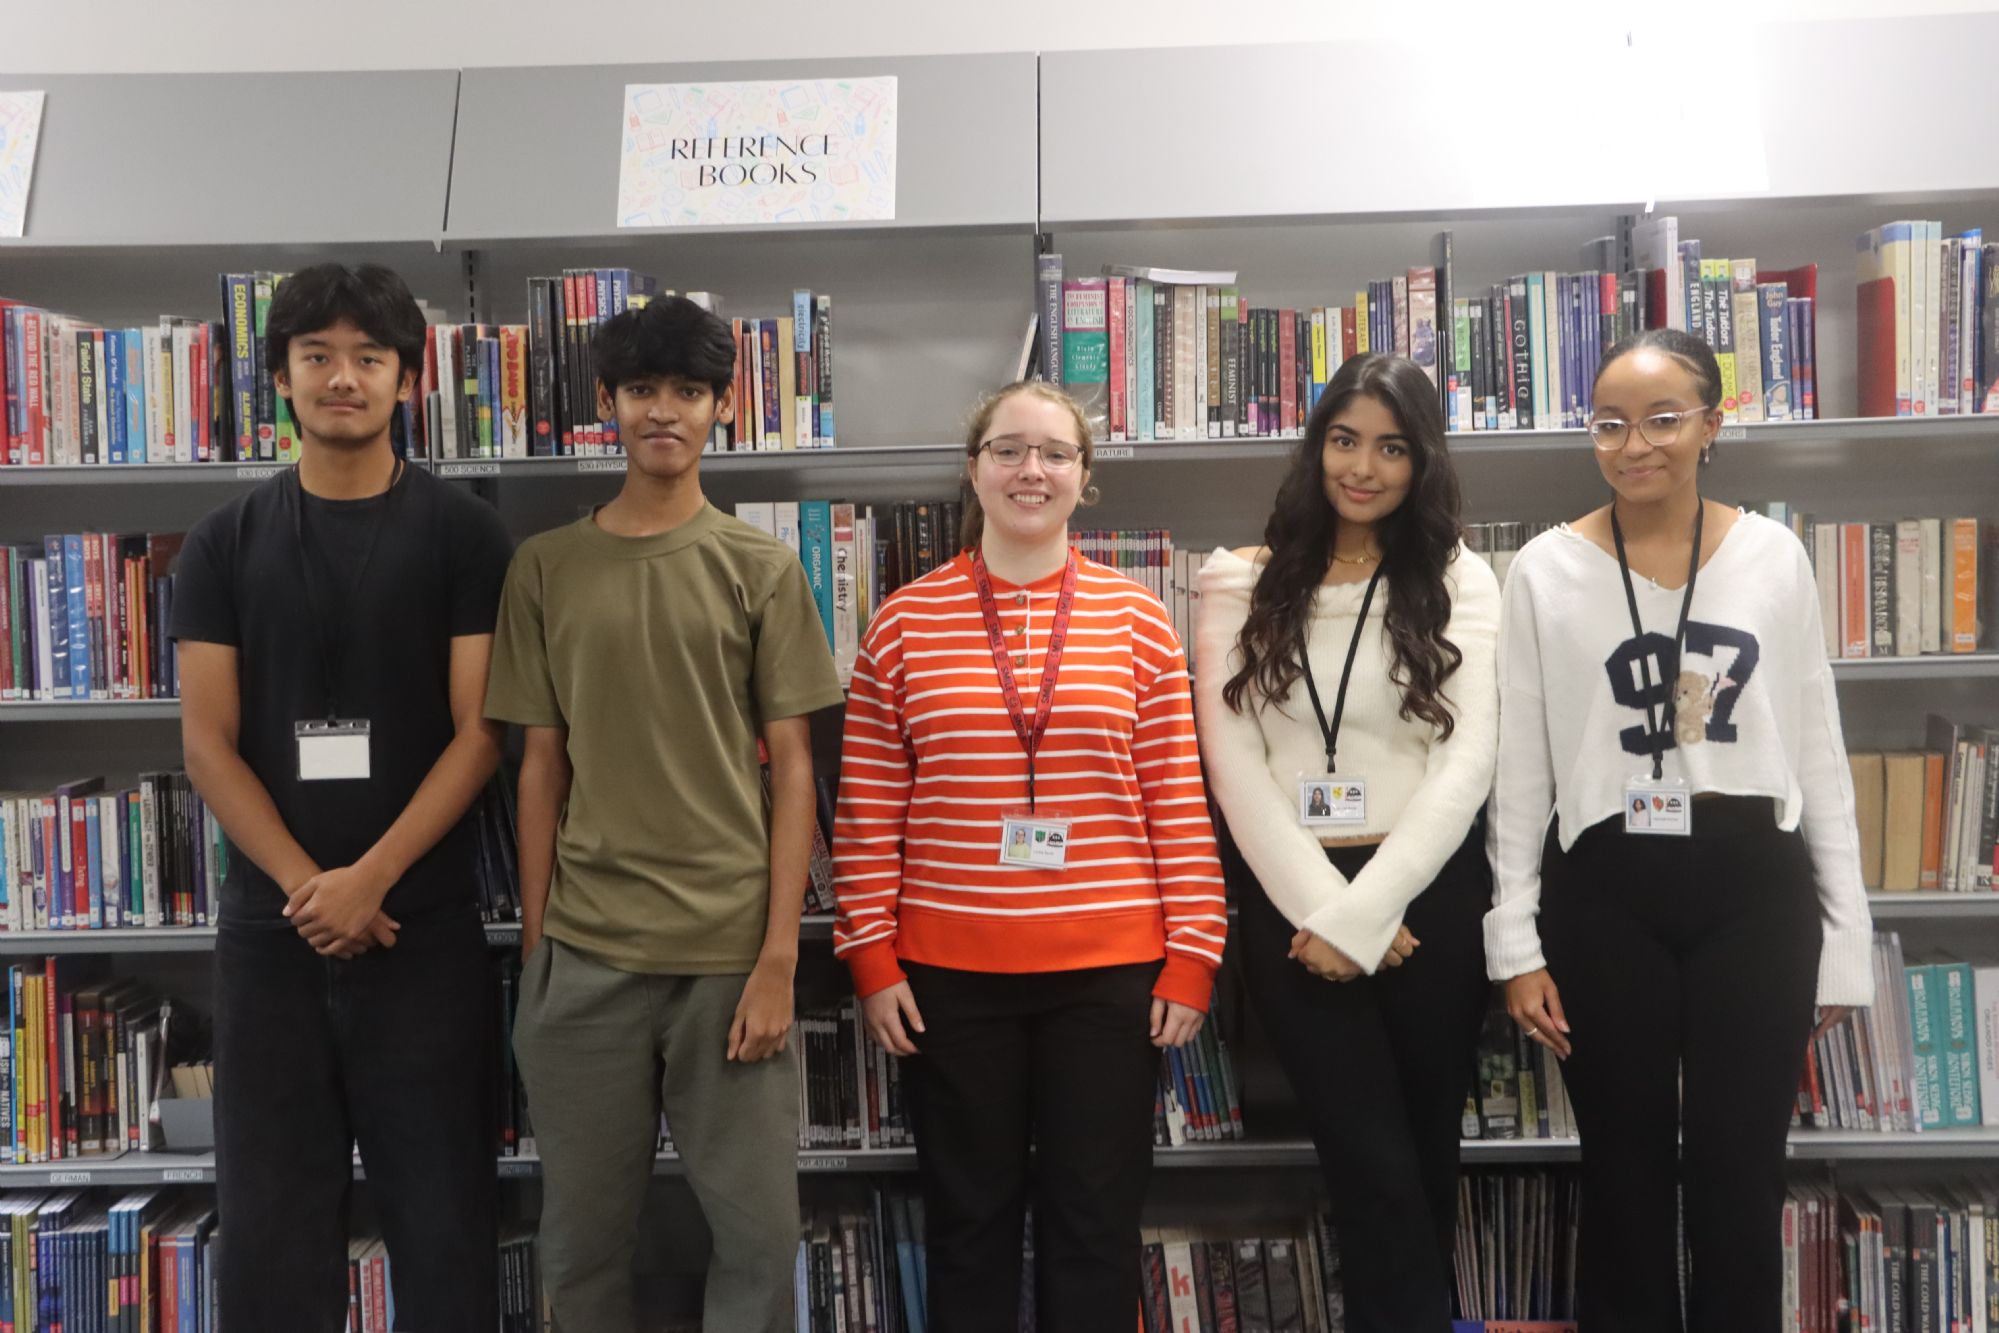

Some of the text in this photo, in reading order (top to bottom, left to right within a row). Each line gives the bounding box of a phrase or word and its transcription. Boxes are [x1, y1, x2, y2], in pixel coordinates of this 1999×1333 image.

[670, 133, 838, 160] REFERENCE
[699, 162, 817, 187] BOOKS
[598, 280, 606, 316] PHYSICS
[1049, 284, 1057, 300] THE
[1690, 282, 1701, 329] ENGLAND
[234, 284, 248, 359] ECONOMICS
[797, 304, 807, 349] electricity
[1050, 303, 1058, 340] ENGLISH
[1704, 290, 1715, 346] The Tudors
[1718, 289, 1730, 346] The Tudors
[28, 353, 38, 368] THE
[1770, 316, 1784, 380] Tudor England
[81, 342, 92, 404] Failed State
[506, 334, 519, 398] BIG BANG
[1228, 357, 1236, 405] FEMINIST
[599, 462, 627, 470] PHYSIC
[1097, 448, 1131, 457] RATURE
[811, 546, 822, 590] ORGANIC
[836, 547, 848, 612] Chemistry
[978, 577, 992, 605] SMILE
[1060, 590, 1072, 616] SMILE
[988, 622, 1002, 648] SMILE
[1050, 632, 1064, 659] SMILE
[1000, 666, 1014, 693] SMILE
[1041, 676, 1054, 704] SMILE
[1891, 1262, 1900, 1281] THE
[1921, 1263, 1929, 1283] THE
[1892, 1282, 1900, 1311] COLD
[1921, 1284, 1929, 1312] COLD
